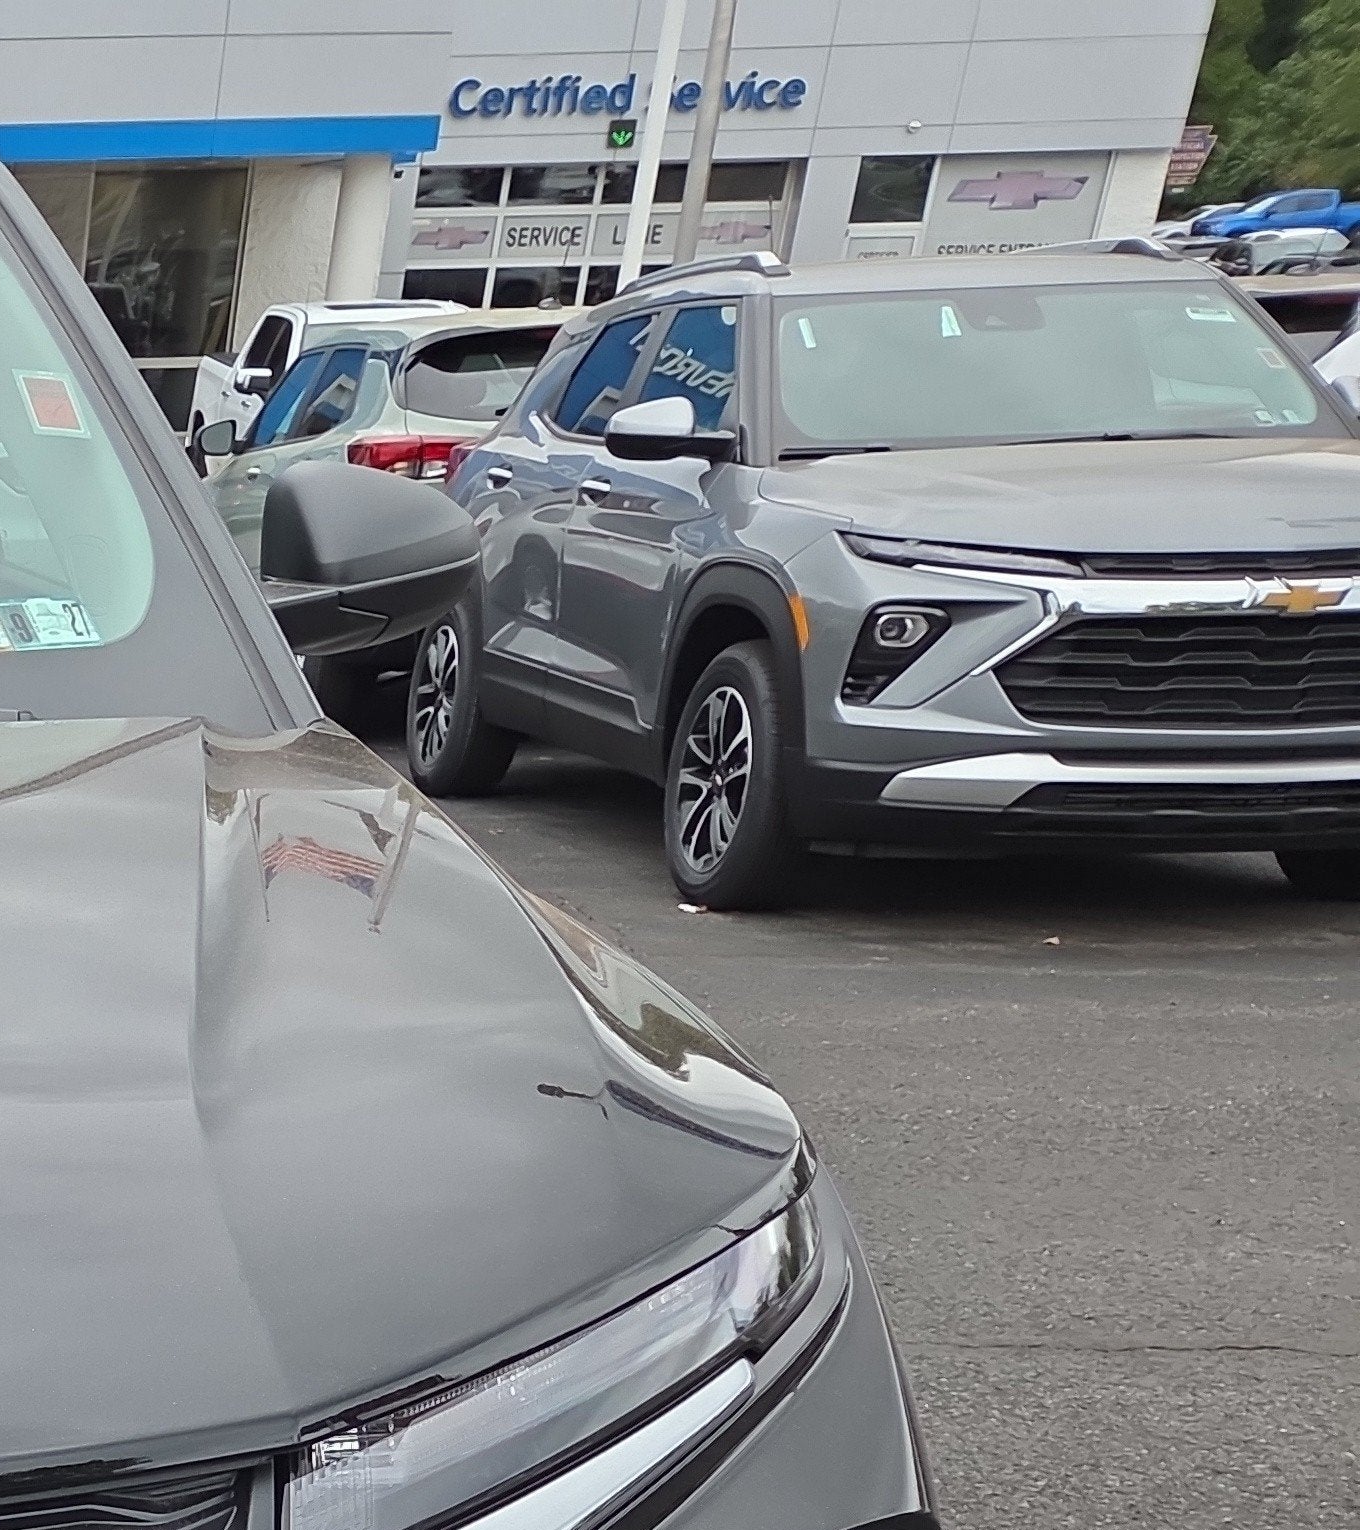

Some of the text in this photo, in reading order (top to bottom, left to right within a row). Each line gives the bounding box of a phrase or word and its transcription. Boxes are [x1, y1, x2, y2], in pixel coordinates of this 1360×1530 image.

[449, 70, 807, 119] Certified evice
[505, 223, 664, 248] SERVICE LE
[61, 602, 91, 639] 27
